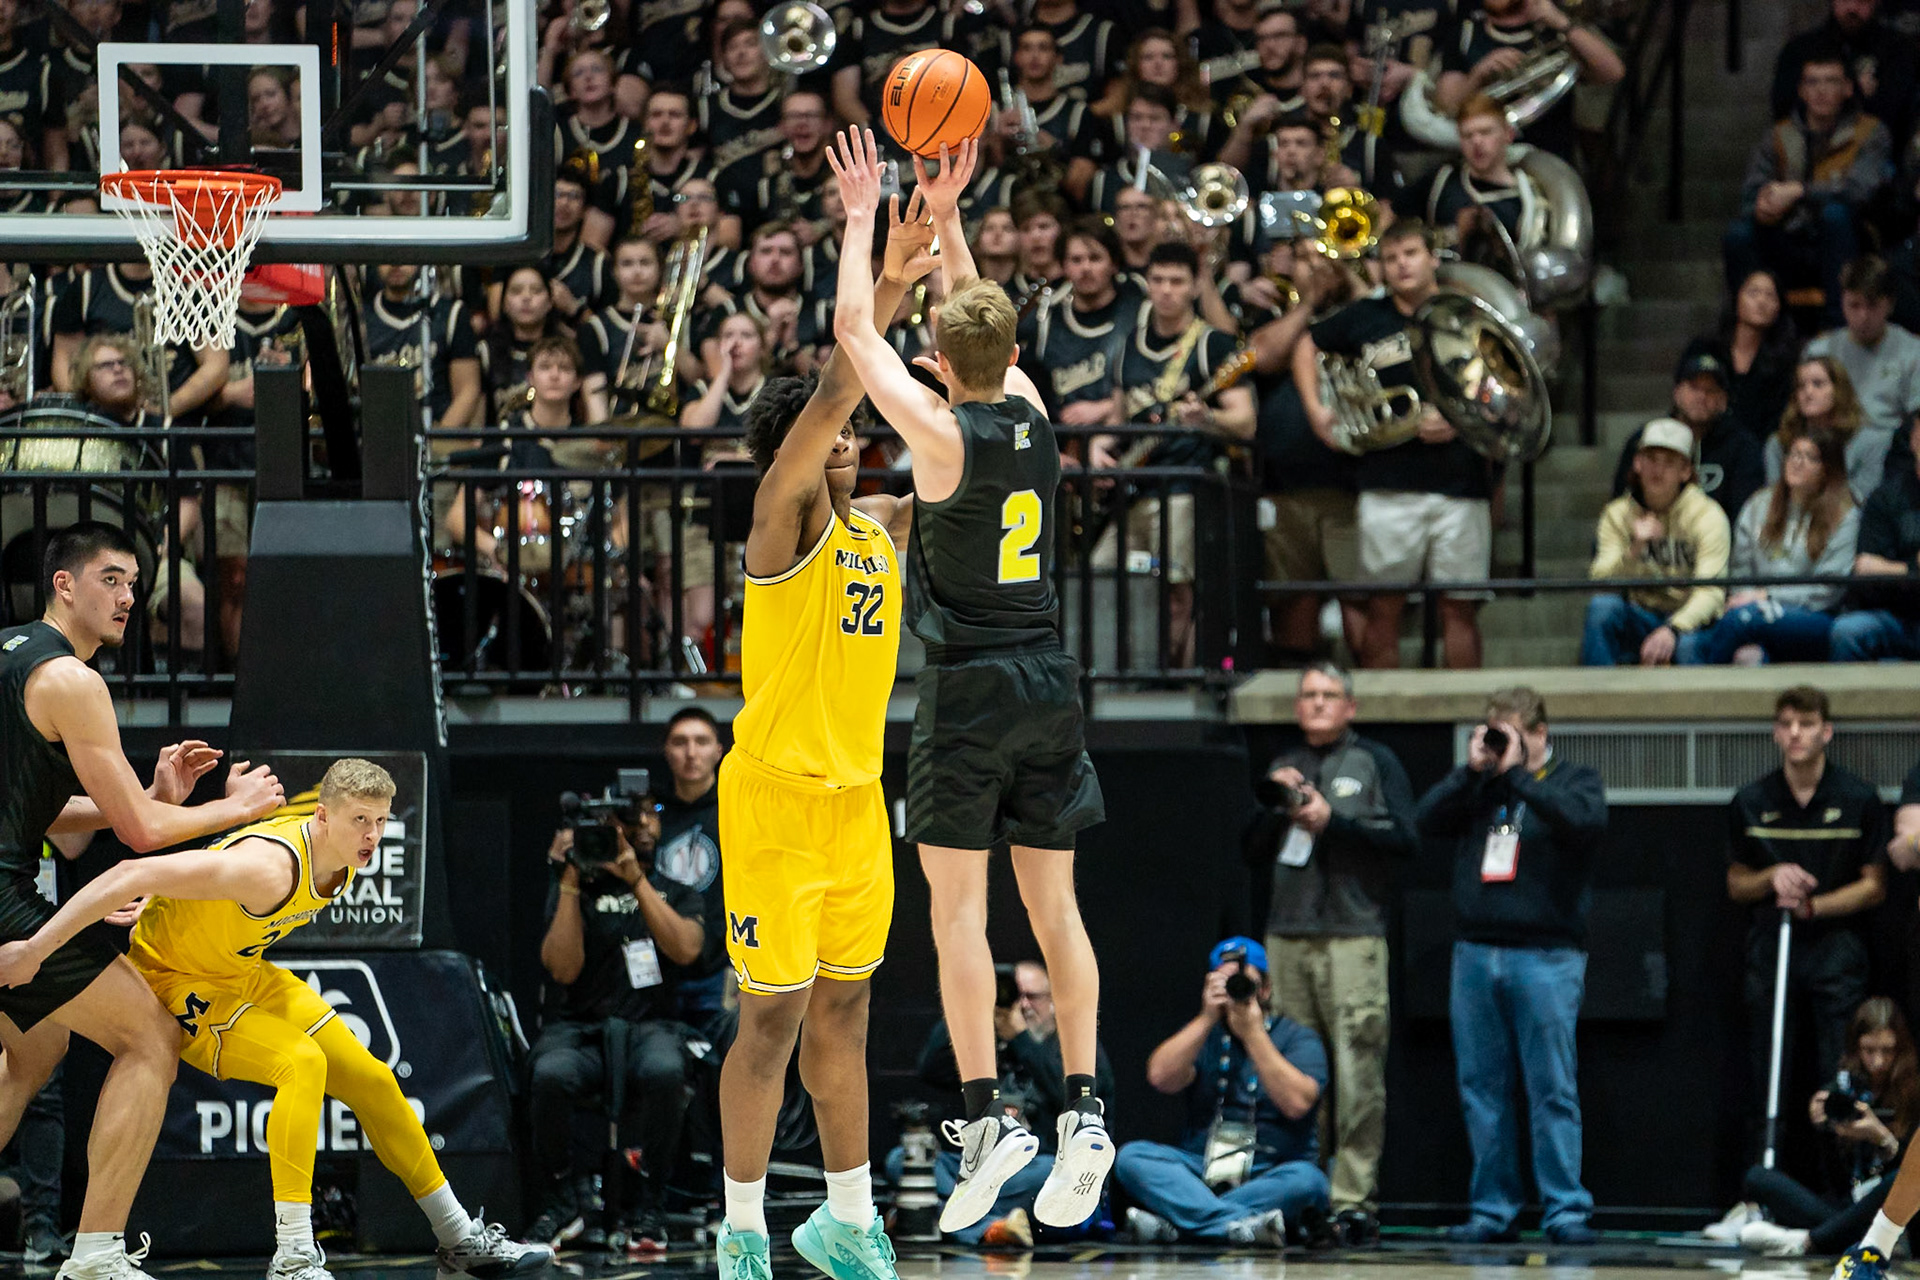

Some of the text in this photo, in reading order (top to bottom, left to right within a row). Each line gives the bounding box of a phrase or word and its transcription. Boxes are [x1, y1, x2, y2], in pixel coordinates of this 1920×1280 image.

[998, 488, 1042, 584] 2
[840, 580, 885, 637] 32
[331, 907, 404, 924] UNION
[729, 910, 760, 949] M
[175, 991, 211, 1038] M
